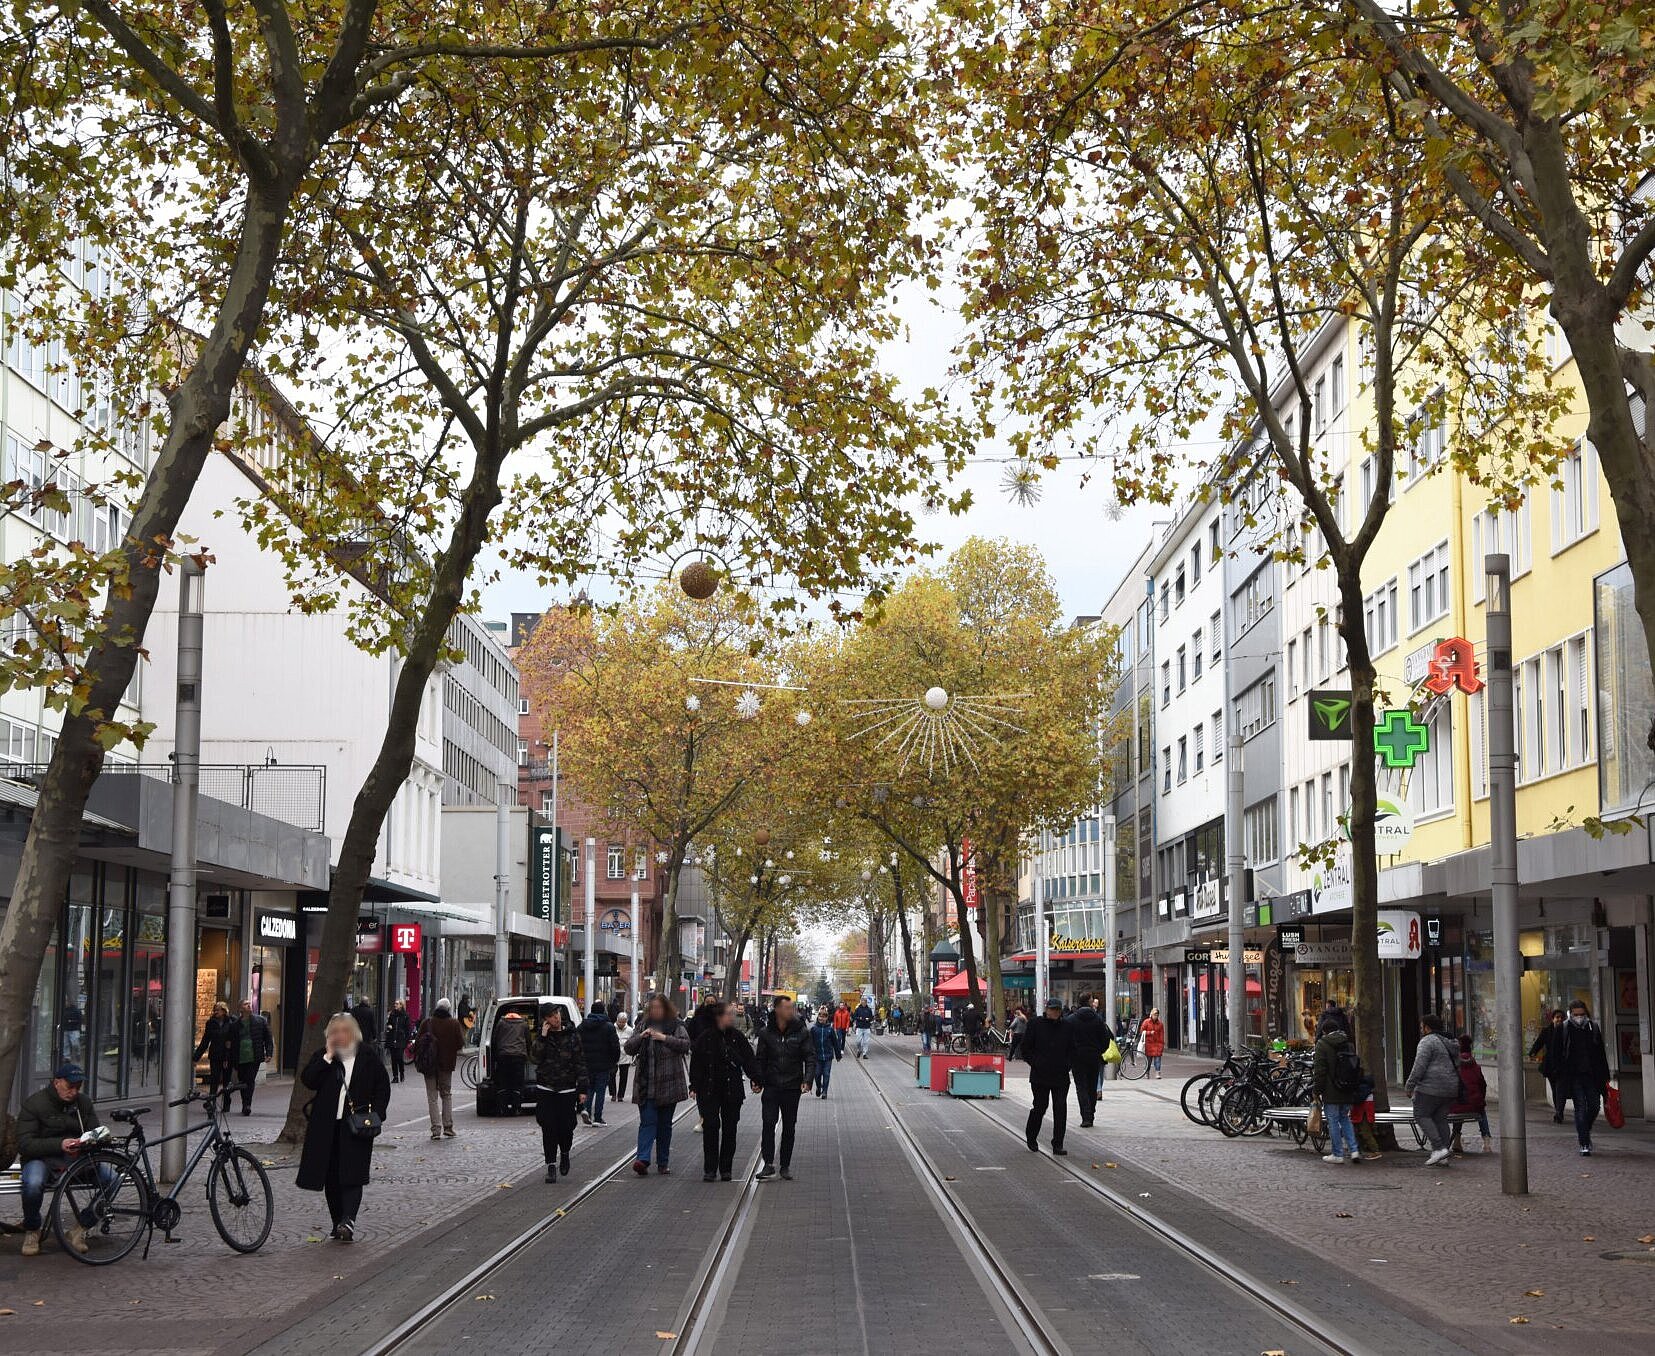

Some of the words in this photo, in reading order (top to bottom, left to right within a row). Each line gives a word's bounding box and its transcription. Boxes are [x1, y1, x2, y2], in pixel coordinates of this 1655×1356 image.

[1376, 825, 1410, 835] TRAL
[1323, 865, 1350, 890] ZENTRAL
[260, 915, 296, 940] CALZEDONIA
[601, 921, 632, 930] BAYER
[397, 928, 415, 949] T
